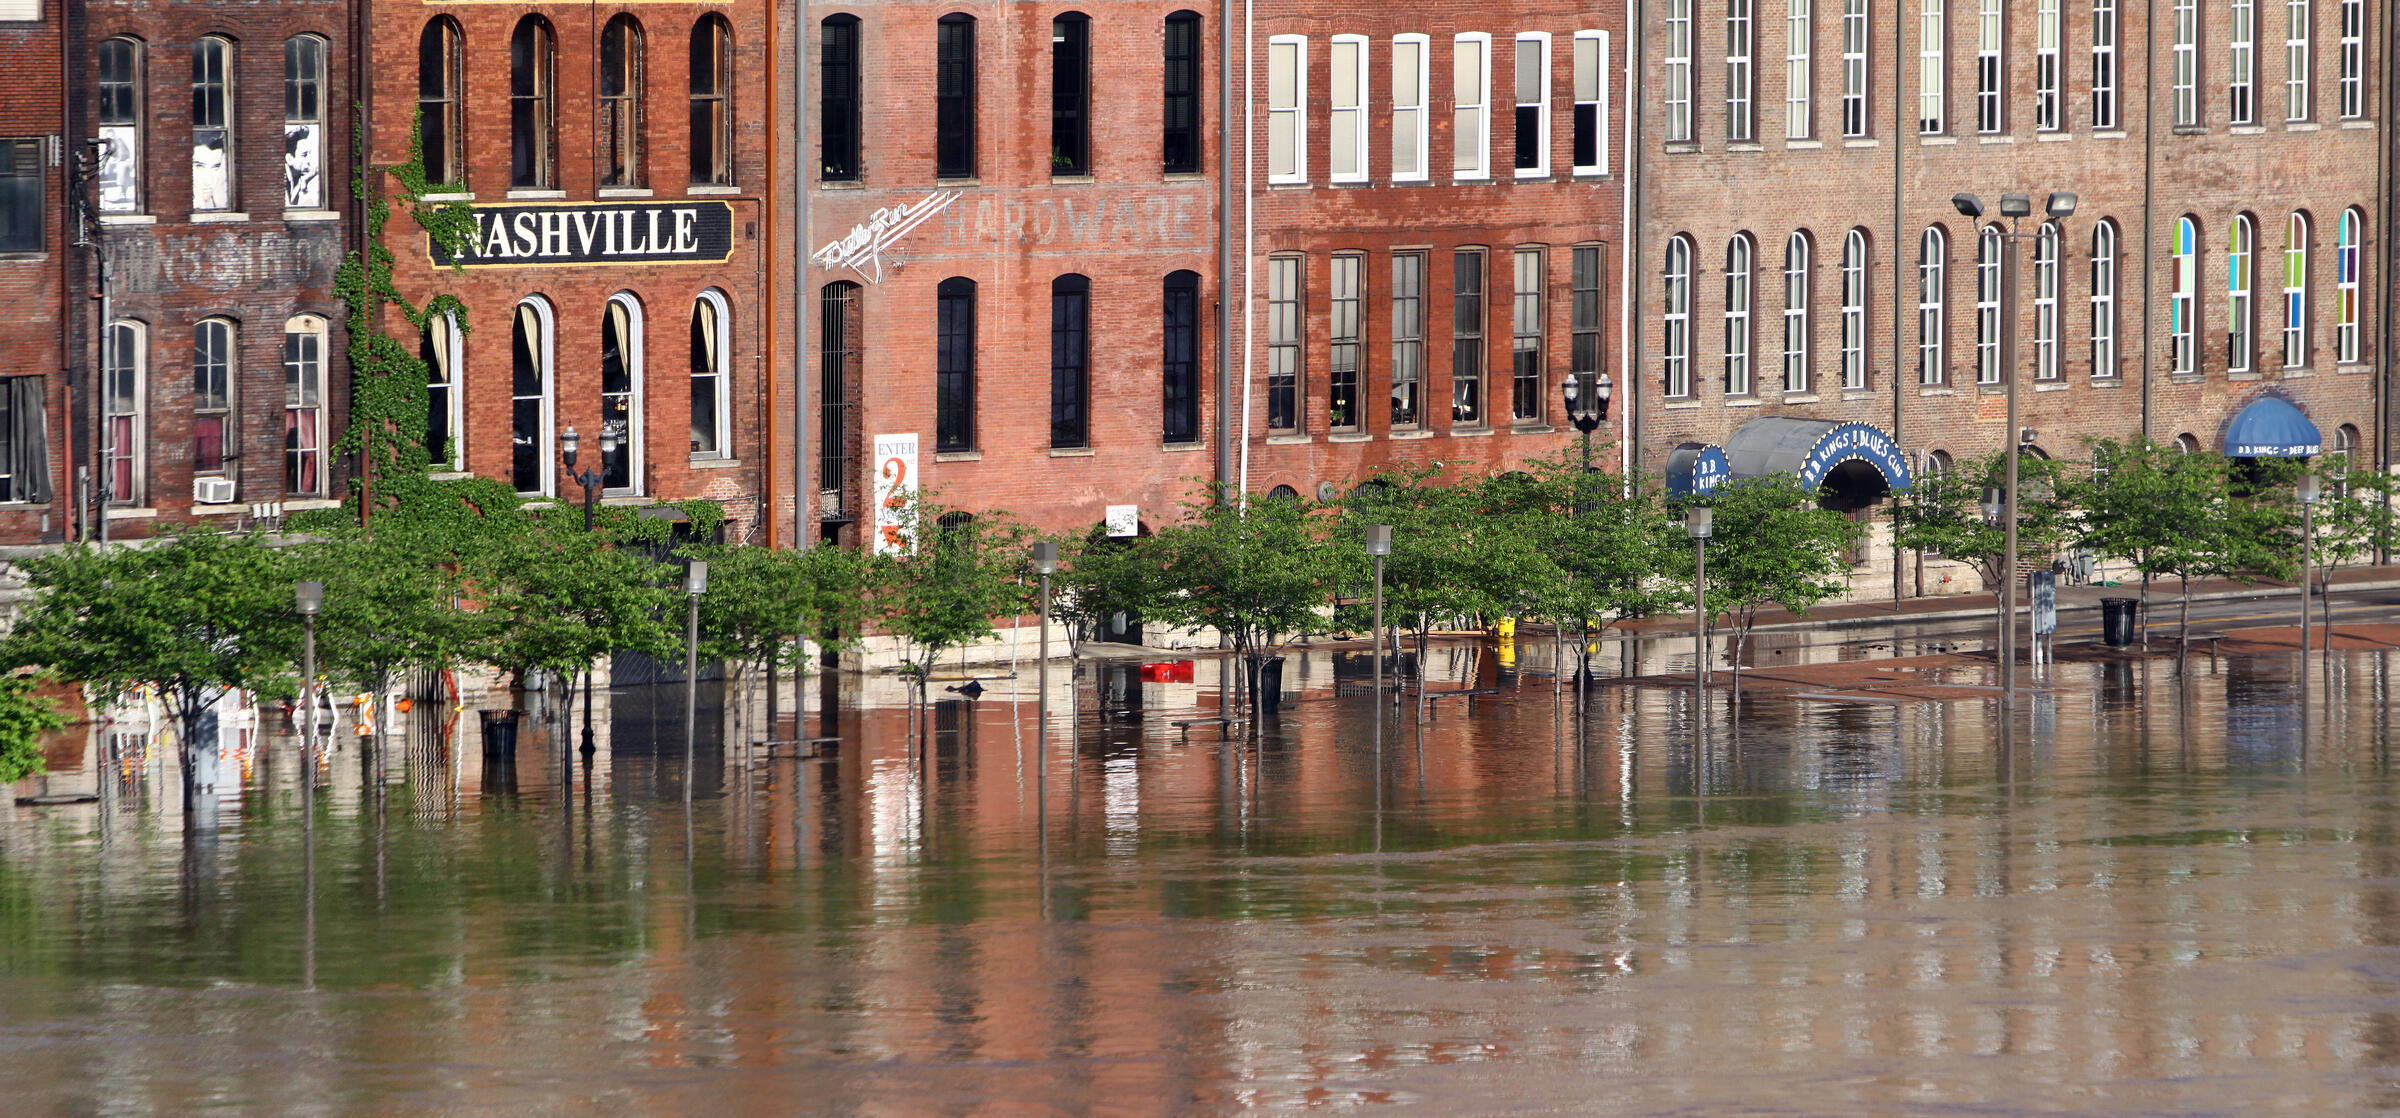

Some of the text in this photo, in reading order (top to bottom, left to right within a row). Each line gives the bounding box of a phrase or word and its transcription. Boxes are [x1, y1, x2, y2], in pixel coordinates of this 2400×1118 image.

[453, 209, 698, 258] NASHVILLE
[943, 195, 1195, 247] HARDWARE
[879, 443, 915, 455] ENTER
[1702, 459, 1717, 474] B.B.
[1820, 432, 1849, 461] KINGS
[1860, 430, 1889, 457] BLUES
[1888, 454, 1903, 478] CLUB
